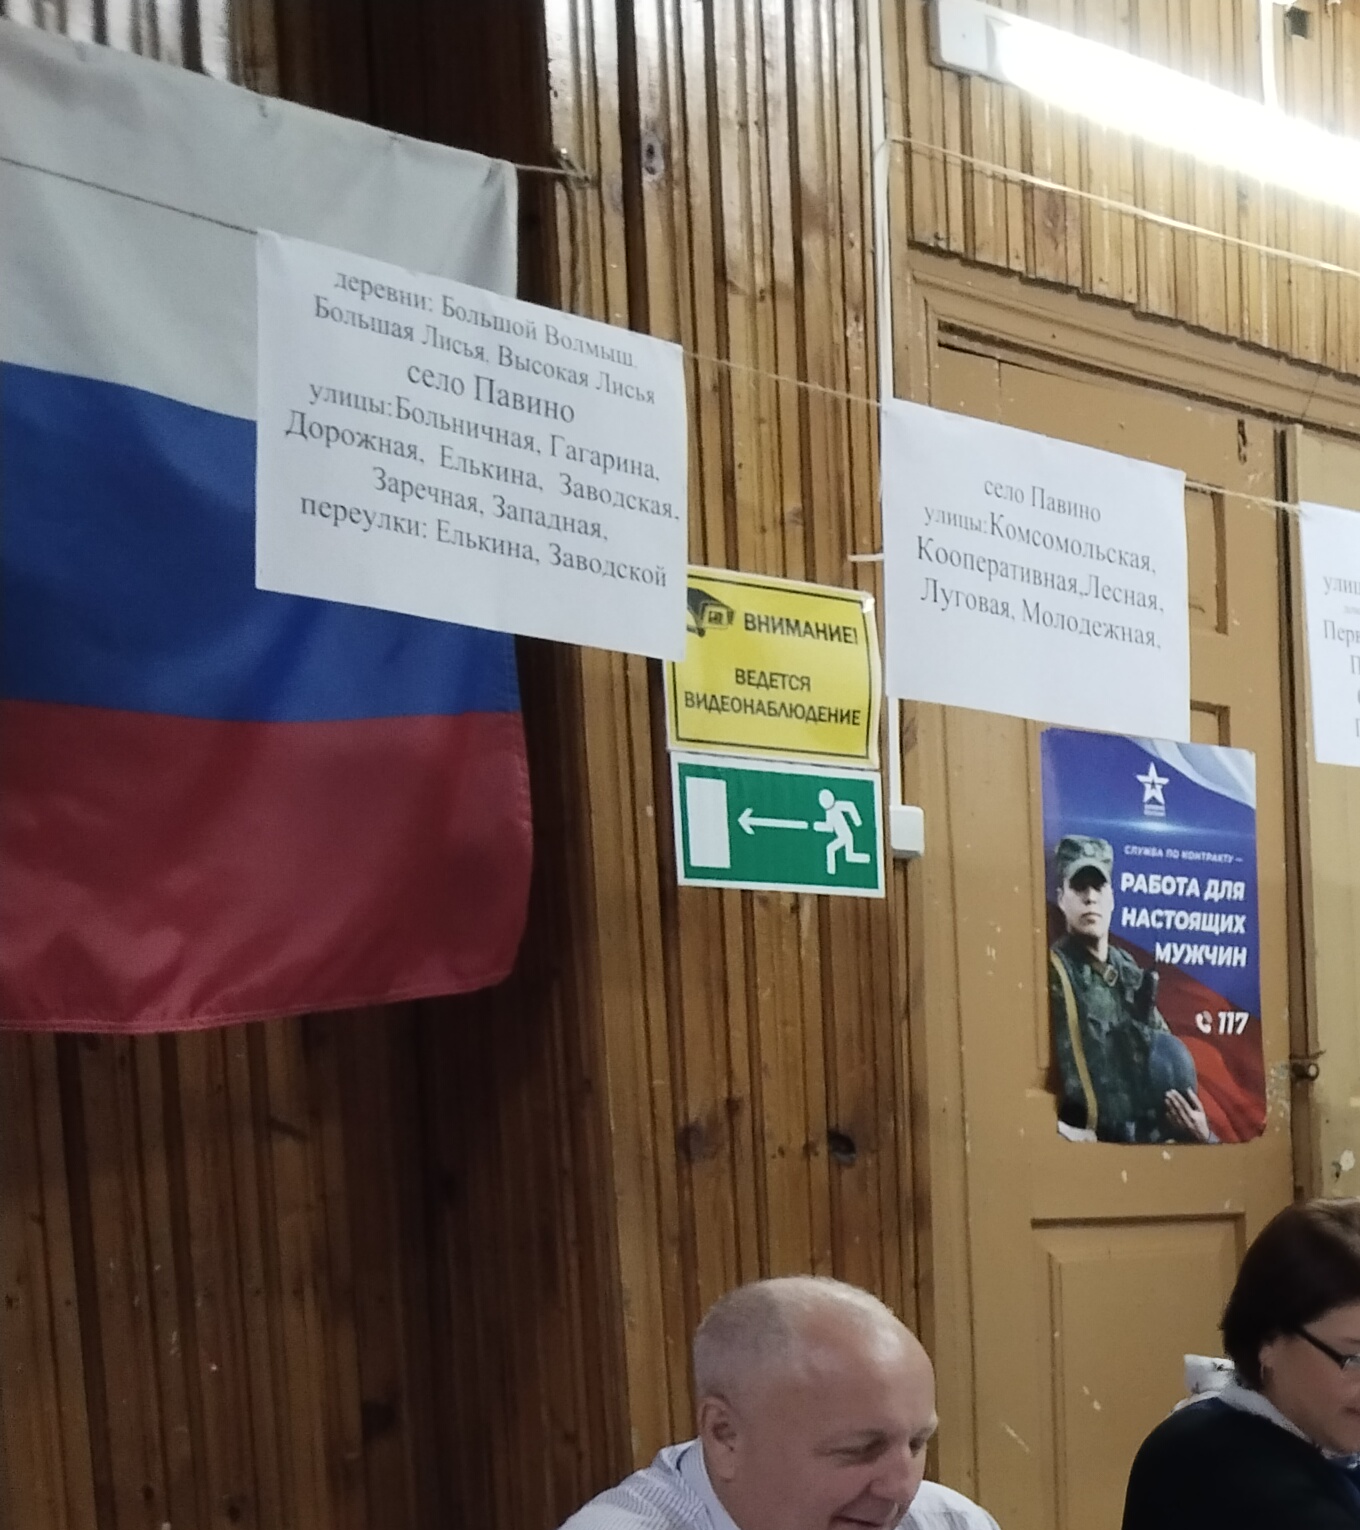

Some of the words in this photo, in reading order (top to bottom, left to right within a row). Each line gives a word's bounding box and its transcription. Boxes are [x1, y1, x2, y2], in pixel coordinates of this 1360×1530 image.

[334, 272, 433, 312] деревни:
[442, 294, 537, 341] Большой
[314, 294, 414, 342] Большая
[498, 344, 589, 387] Высокая
[595, 371, 655, 404] Лисья
[407, 364, 465, 396] село
[474, 374, 575, 423] Павино
[285, 409, 425, 464] Дорожная,
[439, 444, 543, 491] Елькина,
[549, 434, 660, 482] Гагарина,
[372, 466, 485, 516] Заречная,
[492, 494, 608, 541] Западная,
[984, 480, 1024, 504] село
[1031, 485, 1101, 523] Павино
[300, 497, 427, 538] переулки:
[436, 518, 540, 564] Елькина,
[549, 542, 667, 588] Заводской
[920, 577, 1015, 621] Луговая,
[744, 612, 858, 645] ВНИМАНИЕ!
[735, 668, 811, 692] ВЕДЕТСЯ
[684, 691, 861, 726] ВИДЕОНАБЛЮДЕНИЕ
[1124, 845, 1163, 858] СЛУЖБА
[1165, 848, 1179, 859] ПО
[1181, 850, 1234, 864] КОНТРАКТУ
[1121, 872, 1200, 899] РАБОТА
[1204, 877, 1245, 903] ДЛЯ
[1121, 907, 1246, 936] НАСТОЯЩИХ
[1155, 940, 1248, 967] МУЖЧИН
[1218, 1011, 1249, 1035] 117
